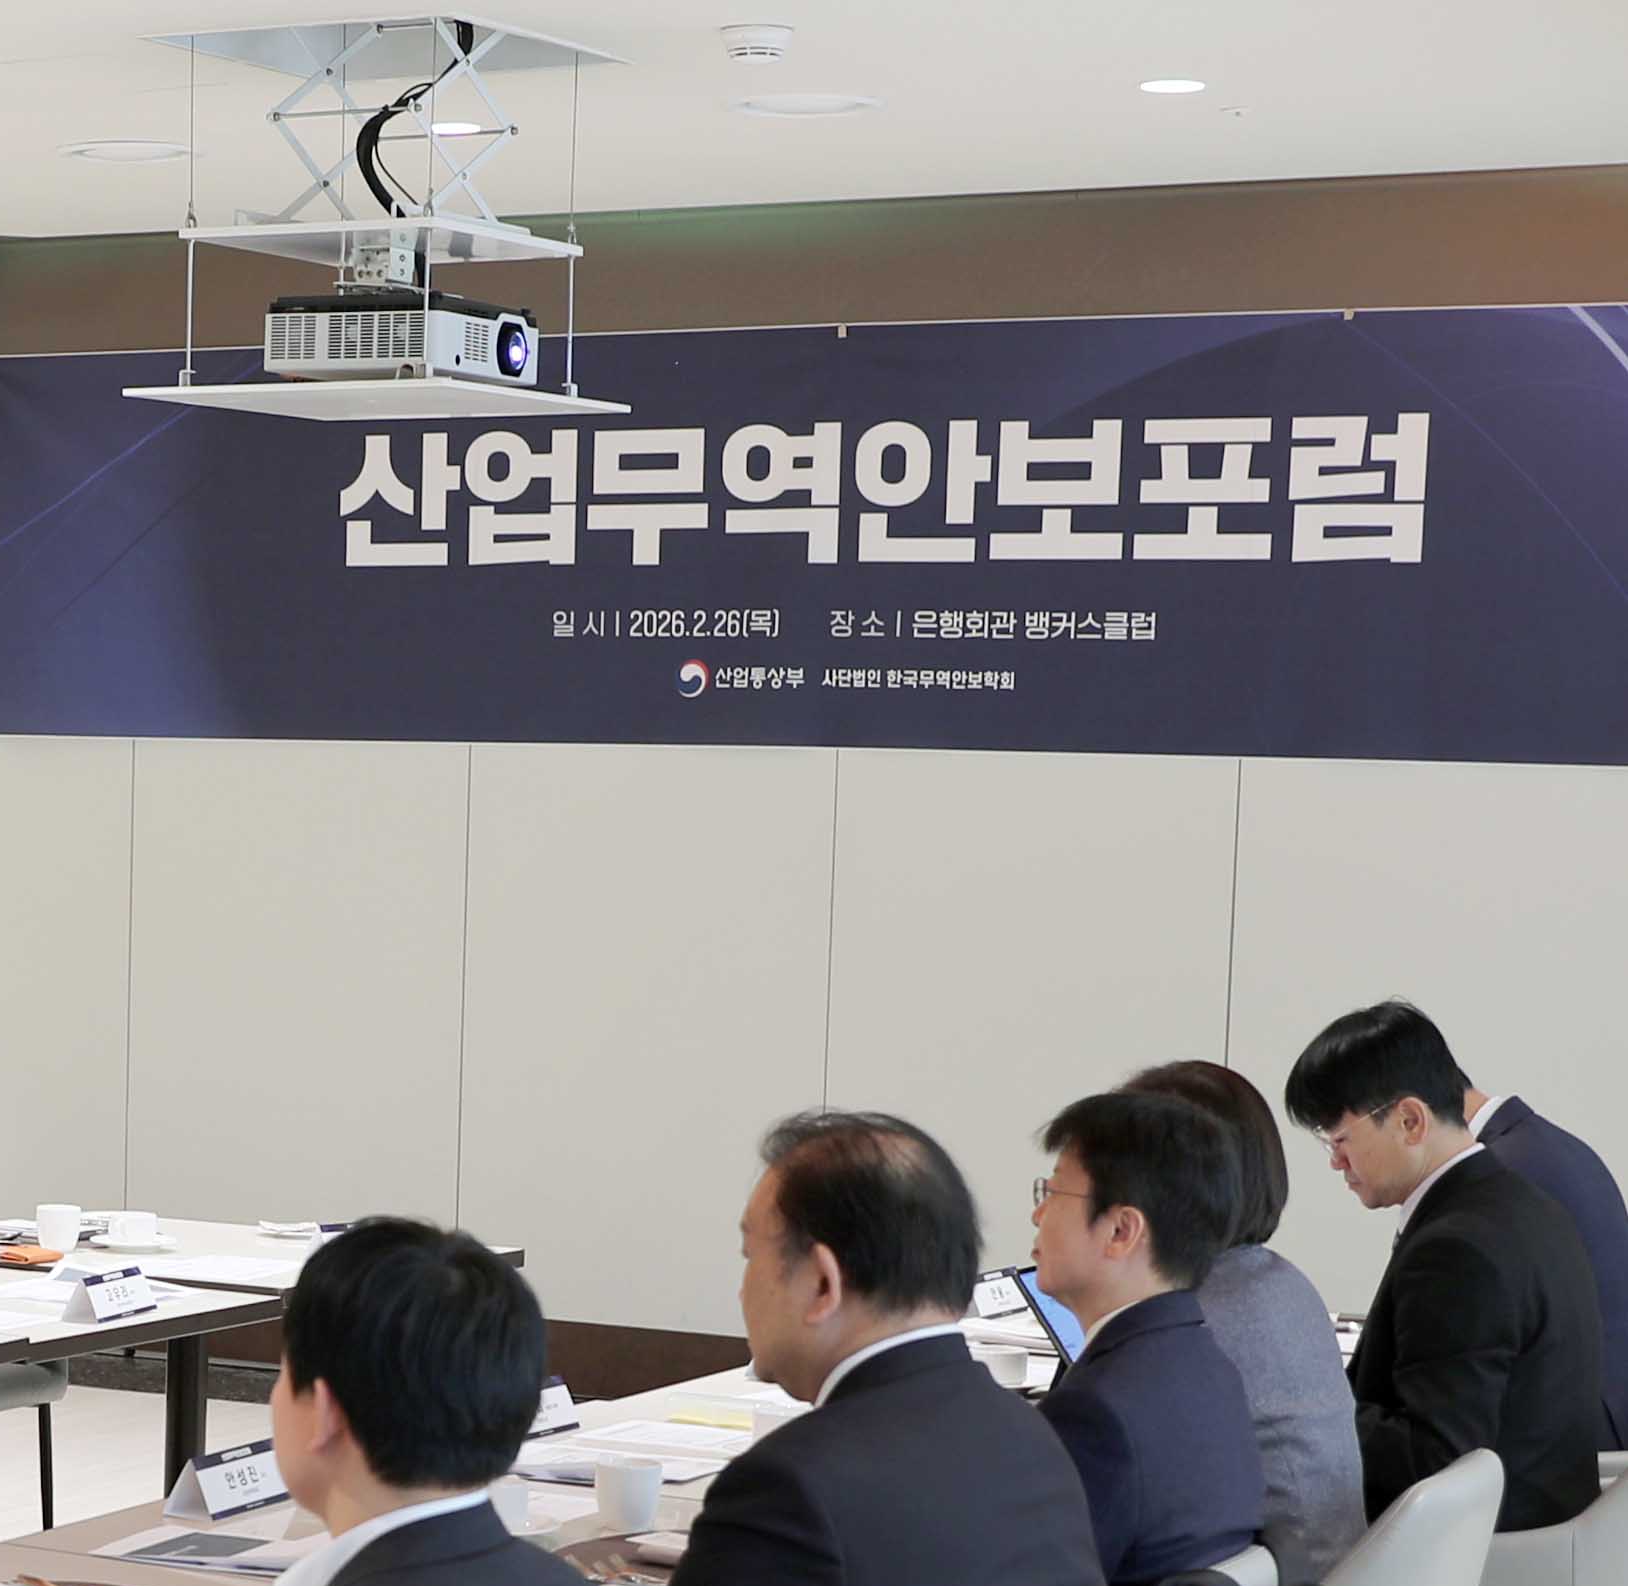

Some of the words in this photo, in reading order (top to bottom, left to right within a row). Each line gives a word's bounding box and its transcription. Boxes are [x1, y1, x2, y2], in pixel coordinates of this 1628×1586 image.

[340, 412, 1430, 567] 산업무역안보포럼
[629, 609, 780, 638] 2026.2.26(목)
[912, 610, 1017, 639] 은행회관
[1025, 611, 1156, 640] 뱅커스클럽
[715, 667, 805, 689] 산업통상부
[822, 669, 882, 688] 사단법인
[886, 670, 1015, 690] 한국무역안보학회
